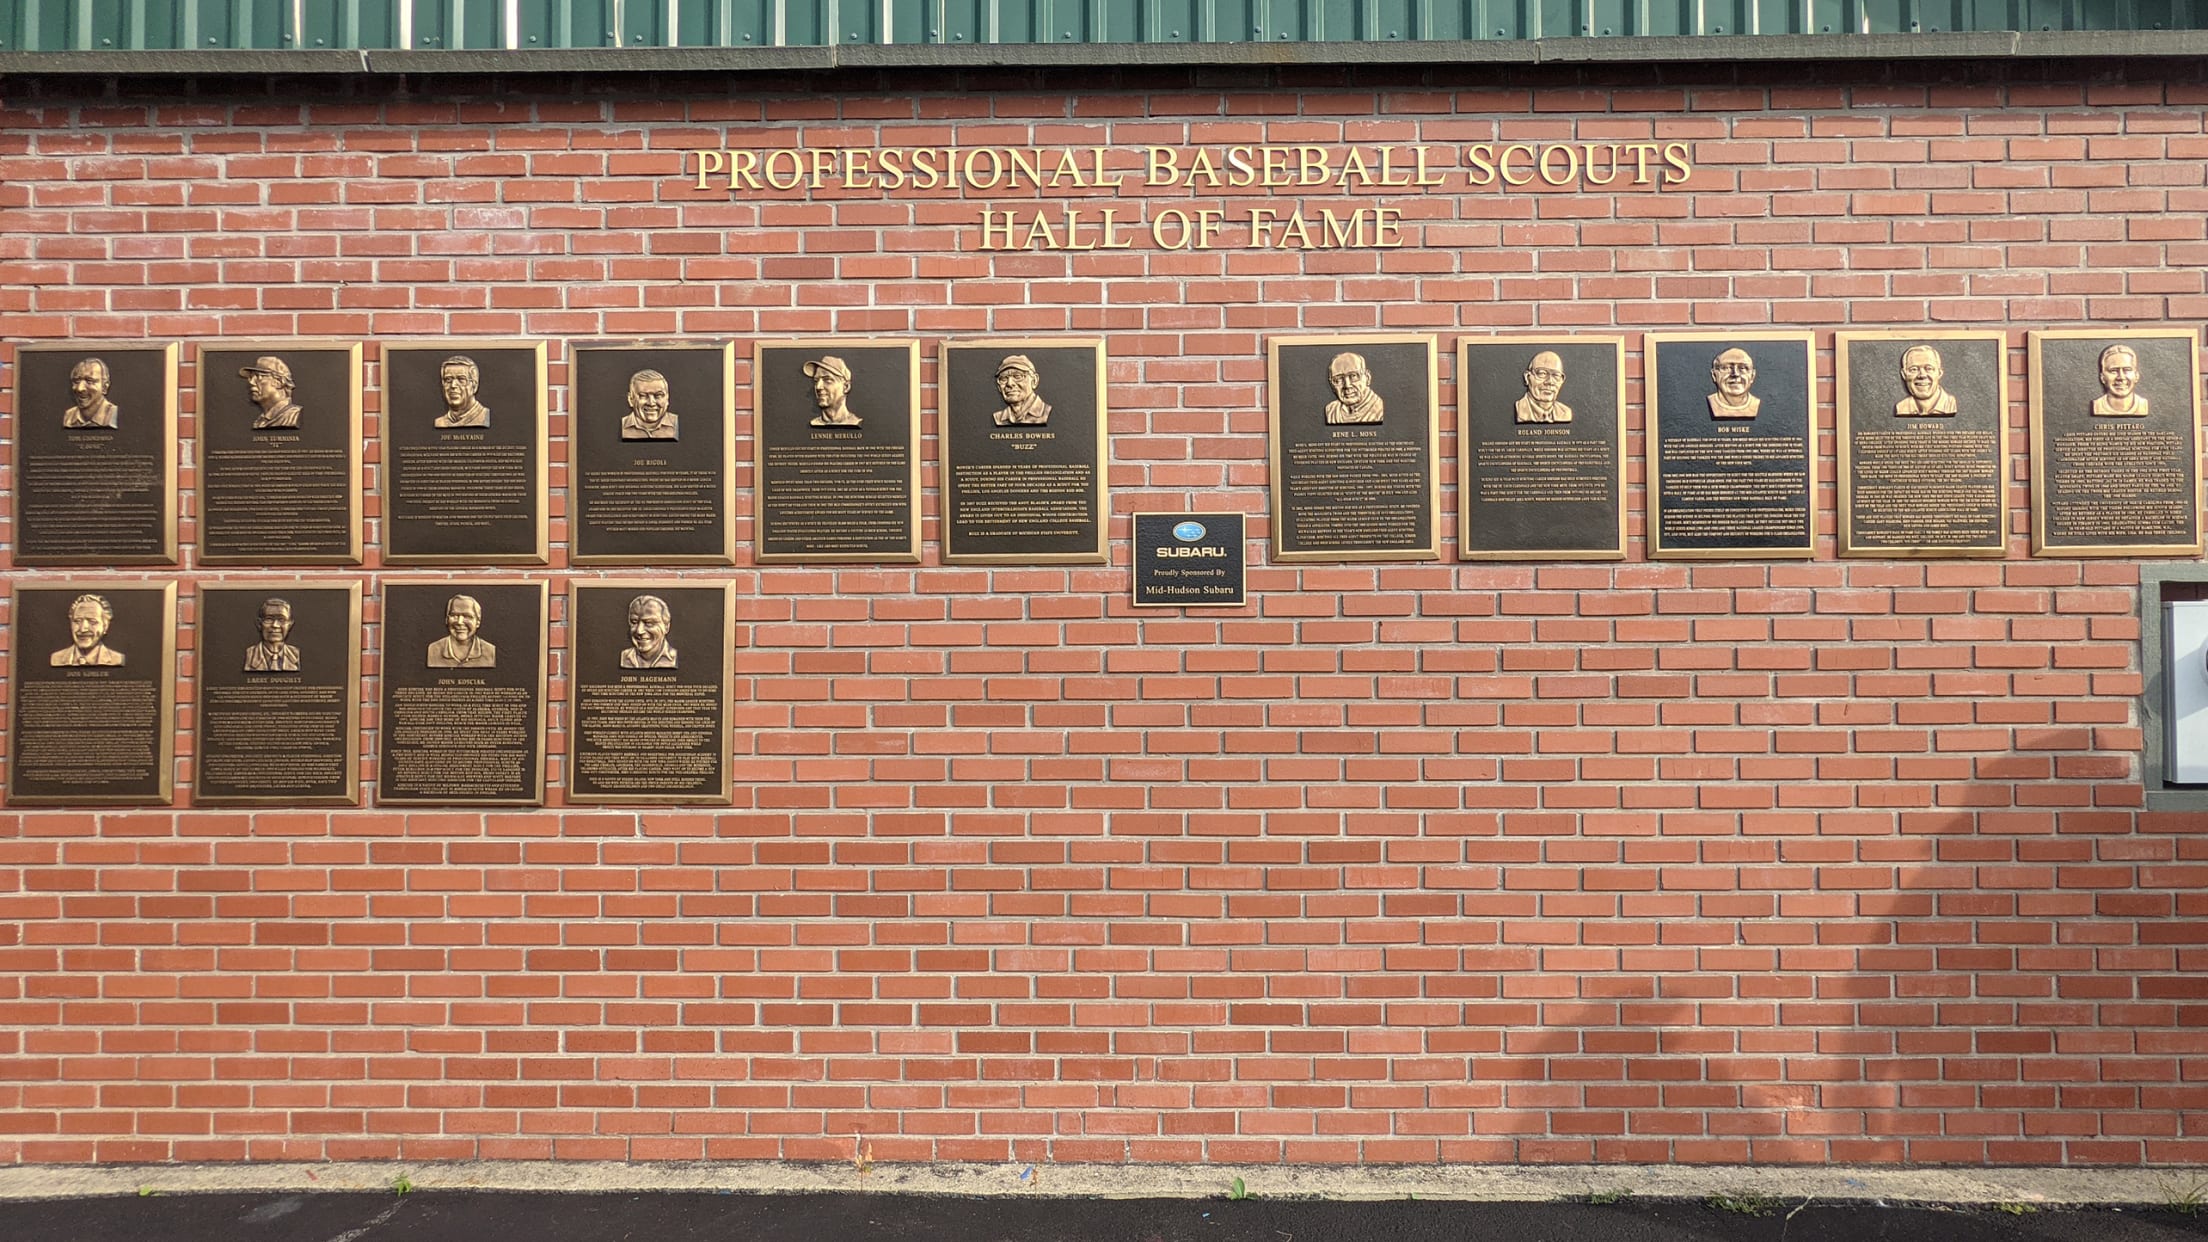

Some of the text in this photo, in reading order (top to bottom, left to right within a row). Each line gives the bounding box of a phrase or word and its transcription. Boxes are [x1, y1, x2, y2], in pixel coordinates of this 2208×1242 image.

[694, 143, 1692, 190] PROFESSIONAL BASEBALL SCOUTS
[979, 207, 1404, 250] HALL OF FAME
[1154, 568, 1226, 578] Proudly Sponsored By
[1146, 585, 1234, 595] Mid-Hudson Subaru
